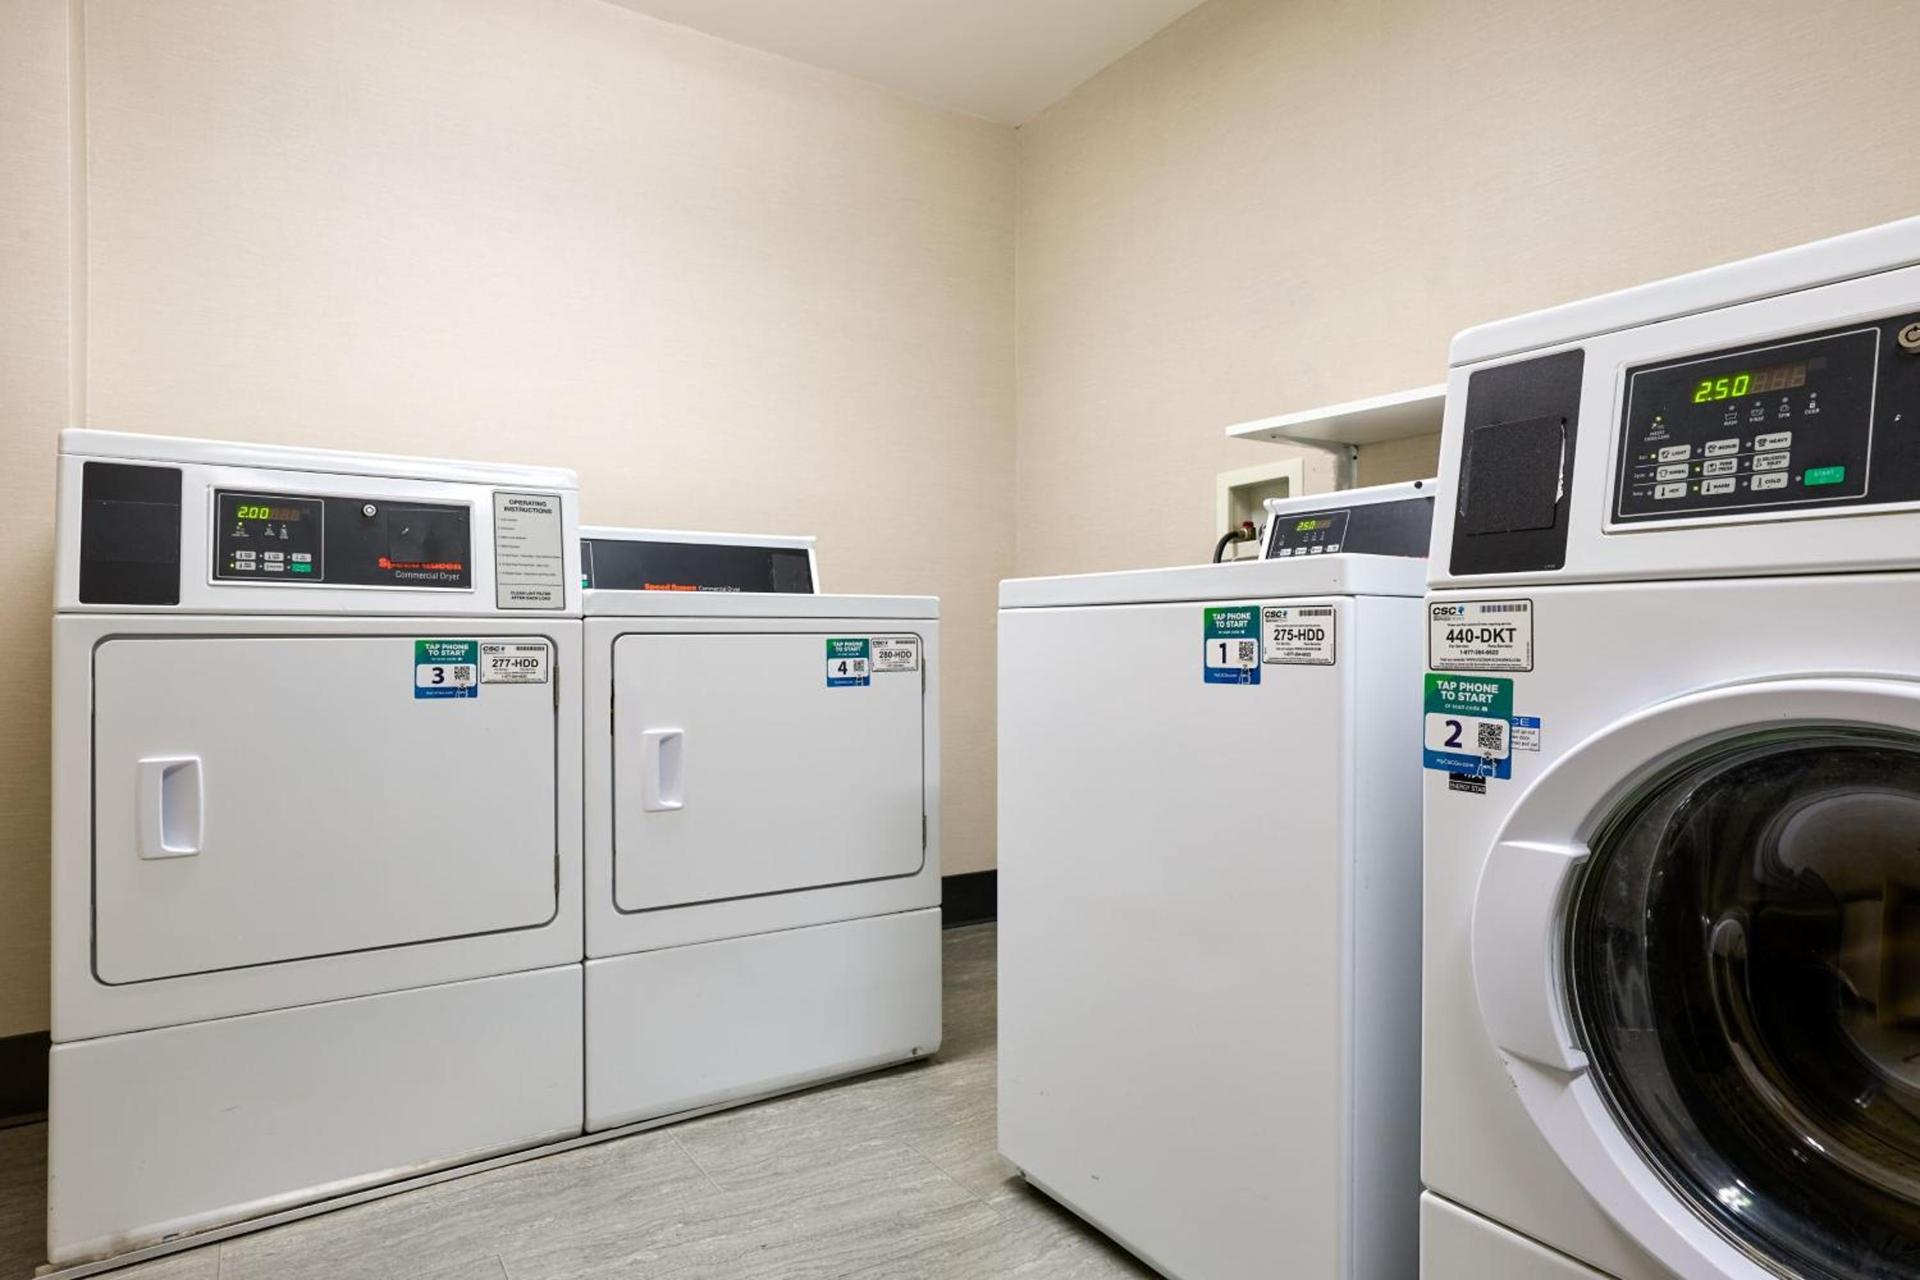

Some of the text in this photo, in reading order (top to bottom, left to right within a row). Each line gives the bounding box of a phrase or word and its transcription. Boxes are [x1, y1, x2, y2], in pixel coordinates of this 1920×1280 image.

[1694, 374, 1750, 403] 2.50
[503, 506, 553, 514] INSTRUCTIONS
[395, 570, 460, 581] Commercial Dryer
[1226, 612, 1251, 620] PHONE
[1433, 606, 1457, 615] CSC
[1215, 620, 1248, 628] TO START
[1273, 629, 1325, 641] 275-HDD
[1446, 627, 1517, 643] 440-DKT
[1219, 642, 1227, 664] 1
[492, 659, 539, 668] 277-HDD
[838, 661, 848, 675] 4
[431, 667, 445, 684] 3
[1436, 680, 1500, 694] TAP PHONE
[1440, 691, 1494, 703] TO START
[1444, 719, 1463, 748] 2
